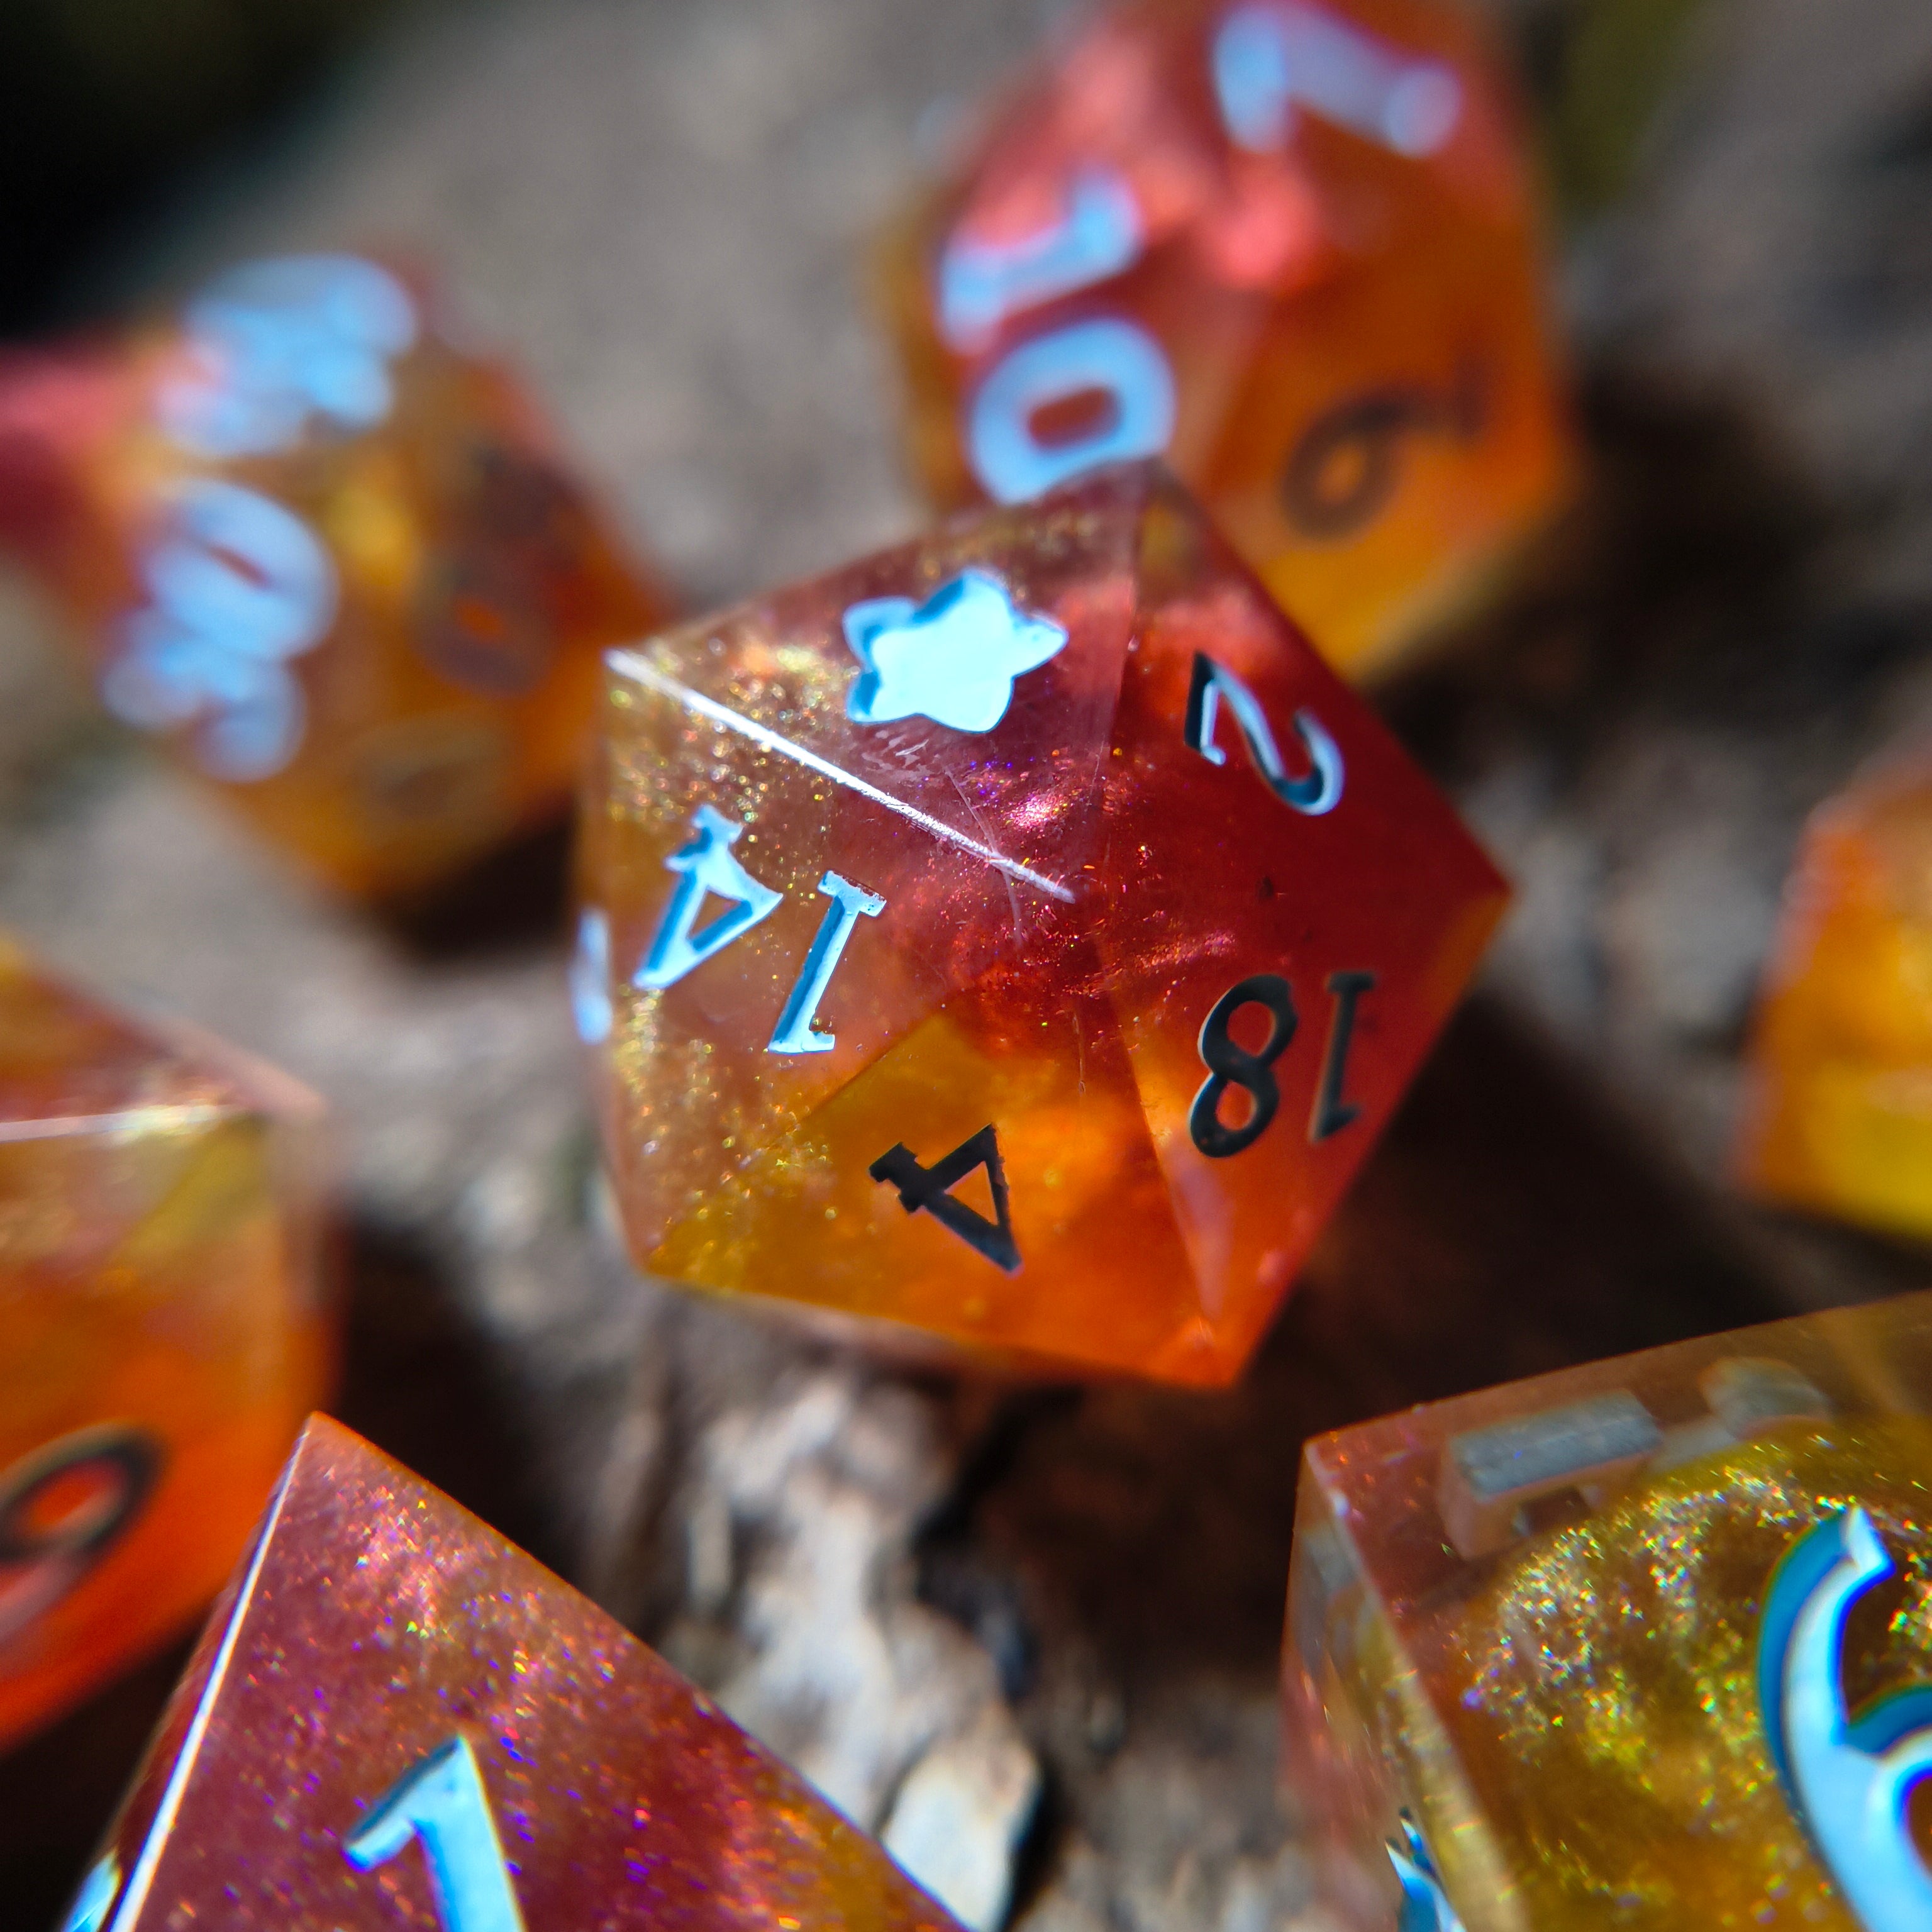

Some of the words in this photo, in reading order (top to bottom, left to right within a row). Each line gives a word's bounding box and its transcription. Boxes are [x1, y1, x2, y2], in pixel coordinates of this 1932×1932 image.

[1184, 648, 1344, 816] 2
[634, 803, 886, 1054] 14
[1189, 971, 1376, 1158] 18
[870, 1122, 1024, 1276] 4
